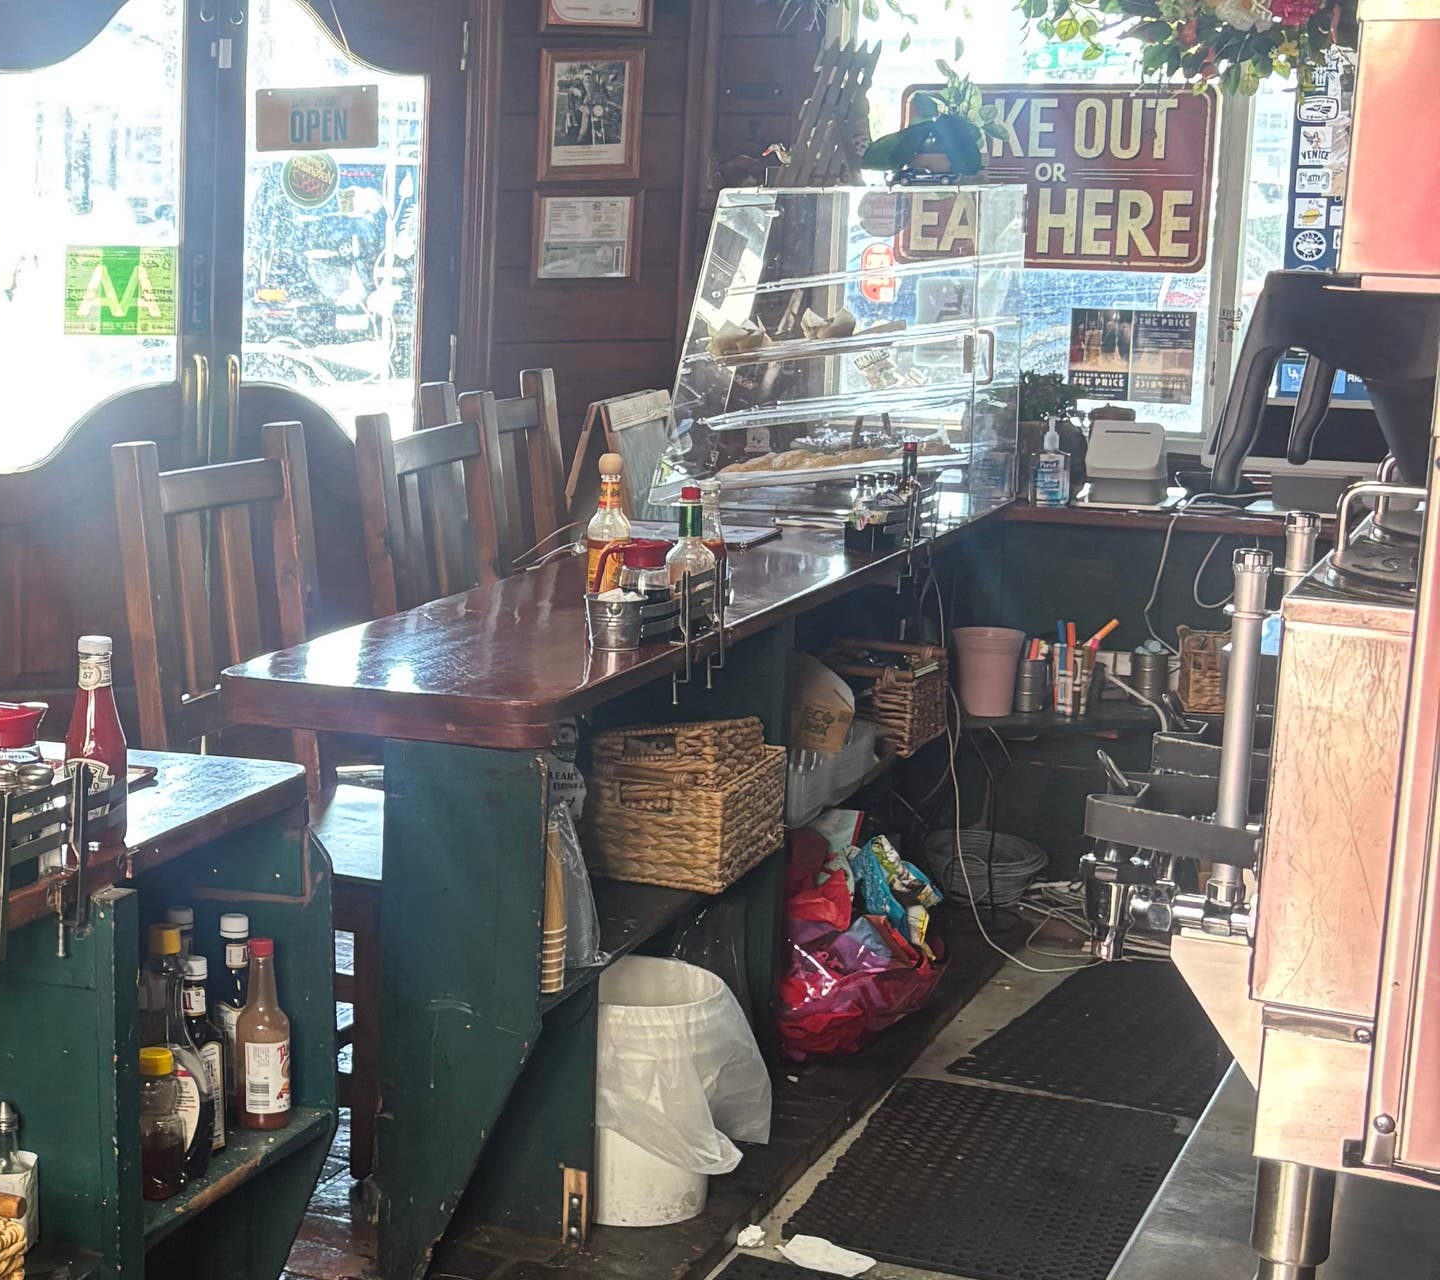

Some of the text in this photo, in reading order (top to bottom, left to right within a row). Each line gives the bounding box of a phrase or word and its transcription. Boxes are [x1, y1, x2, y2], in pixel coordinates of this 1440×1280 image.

[289, 109, 348, 144] OPEN
[1074, 97, 1179, 160] OUT
[1301, 149, 1330, 161] VENICE
[1034, 162, 1067, 183] OR
[909, 187, 1194, 258] EA HERE
[1161, 319, 1191, 327] PRICE
[1072, 377, 1125, 387] THE PRICE
